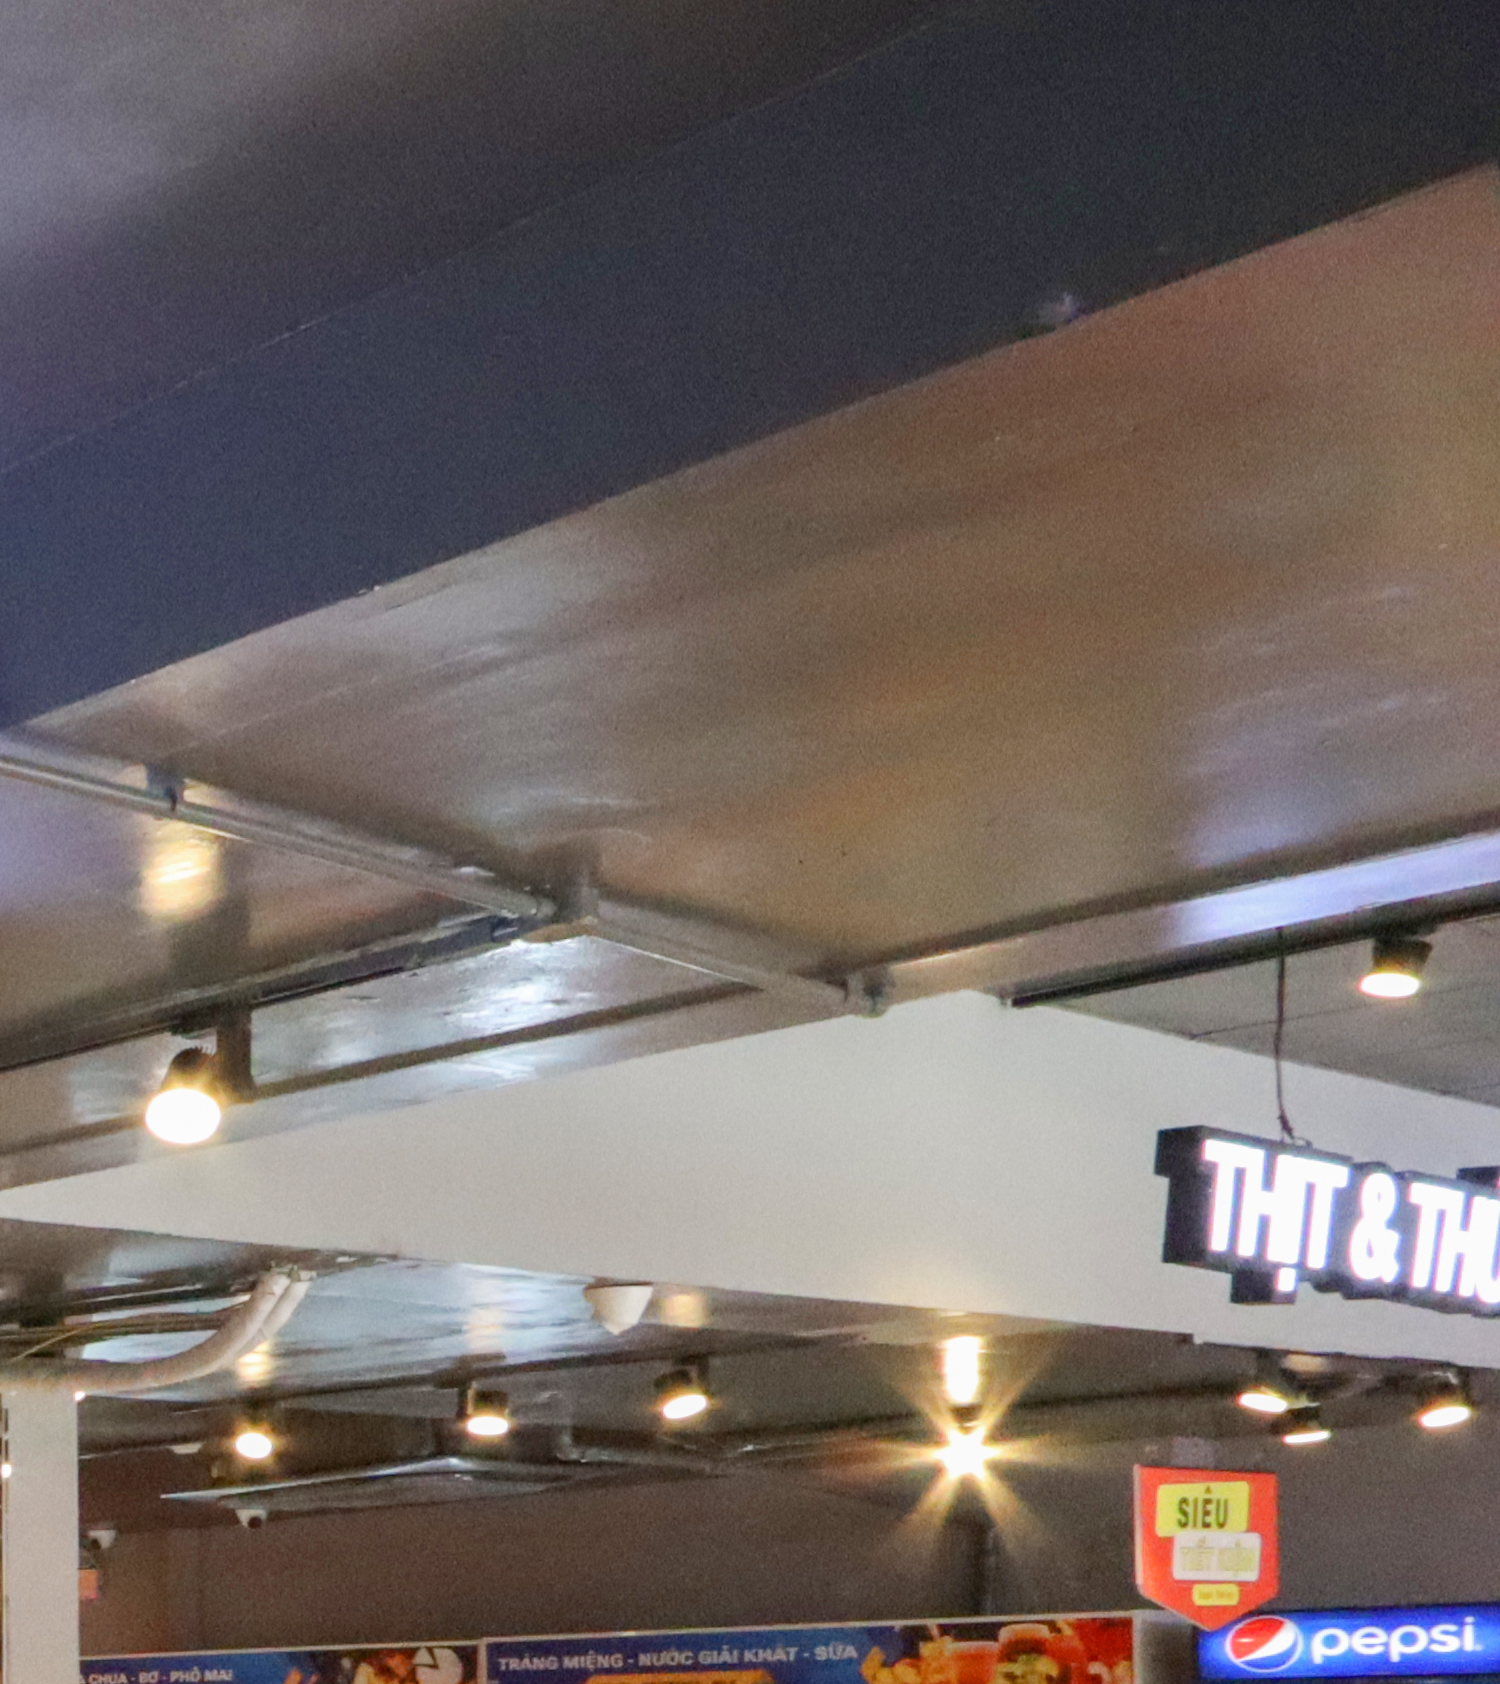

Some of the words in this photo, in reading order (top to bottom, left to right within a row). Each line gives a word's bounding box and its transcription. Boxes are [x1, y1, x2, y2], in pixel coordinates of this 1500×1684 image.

[1204, 1139, 1349, 1292] THỊT
[1349, 1173, 1399, 1282] &
[1178, 1485, 1229, 1529] SIÊU
[499, 1654, 558, 1671] TRÁNG
[563, 1653, 623, 1672] MIỆNG
[743, 1643, 799, 1662] KHÁT
[1310, 1616, 1476, 1662] pepsi
[88, 1673, 128, 1684] CHUA
